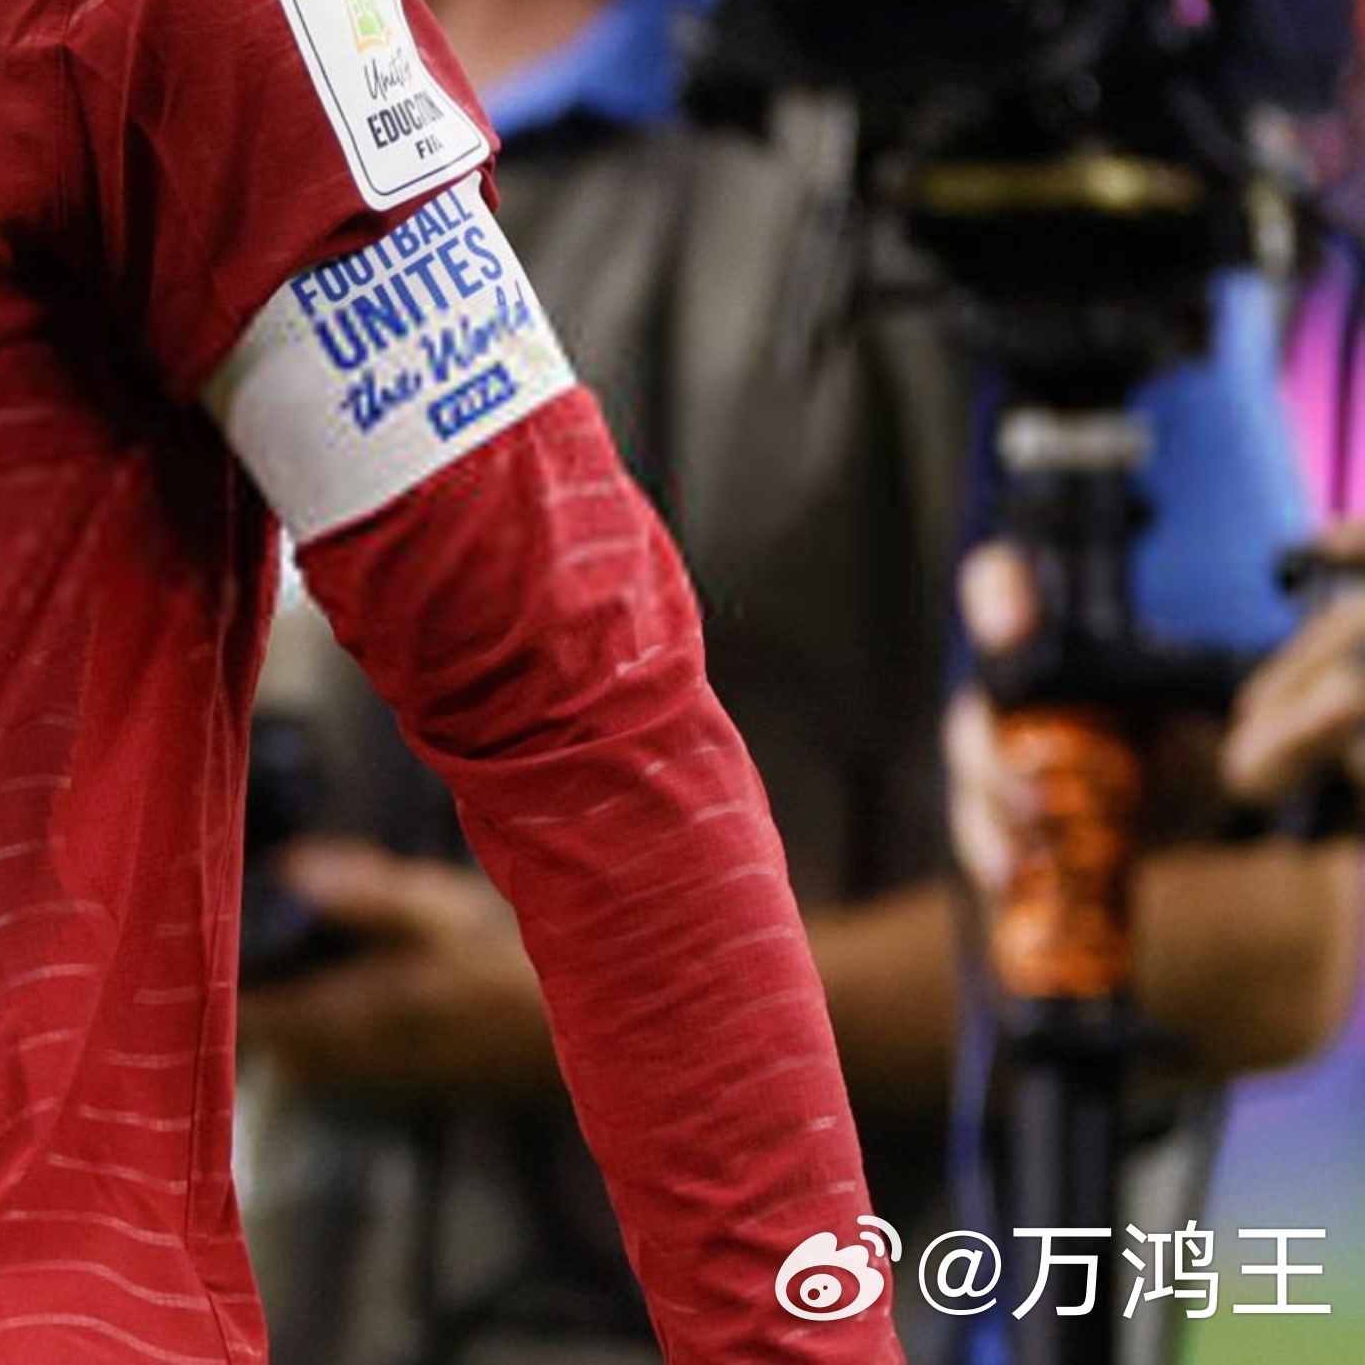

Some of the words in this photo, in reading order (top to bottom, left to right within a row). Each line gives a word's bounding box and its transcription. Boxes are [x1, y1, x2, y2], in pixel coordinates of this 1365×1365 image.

[414, 134, 444, 160] FI
[290, 187, 474, 317] FOOTBALL
[315, 225, 503, 372] UNITES
